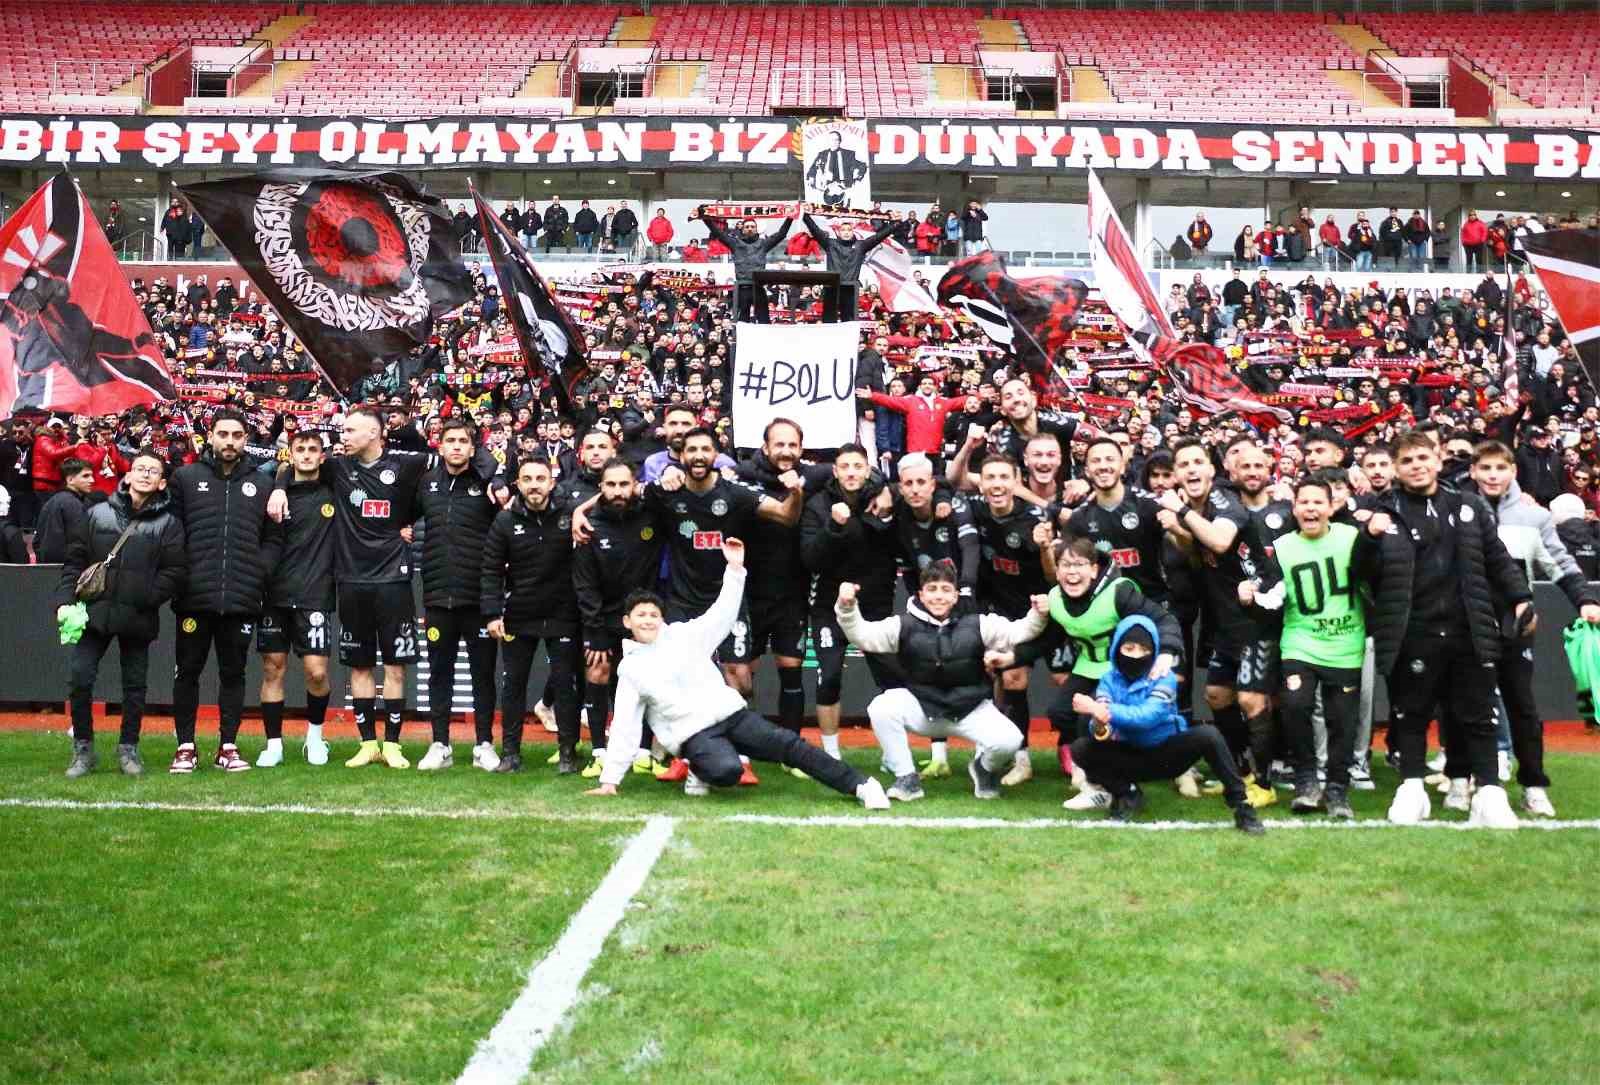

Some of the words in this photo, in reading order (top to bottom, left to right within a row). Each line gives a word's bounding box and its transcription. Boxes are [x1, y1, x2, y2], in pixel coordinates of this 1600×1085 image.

[0, 115, 120, 164] BİR
[142, 117, 297, 168] ŞEYİ
[319, 122, 647, 165] OLMAYAN
[669, 117, 789, 164] BİZ
[1231, 130, 1510, 177] SENDEN
[739, 358, 854, 405] #BOLU
[307, 627, 325, 649] 11
[394, 637, 415, 658] 22
